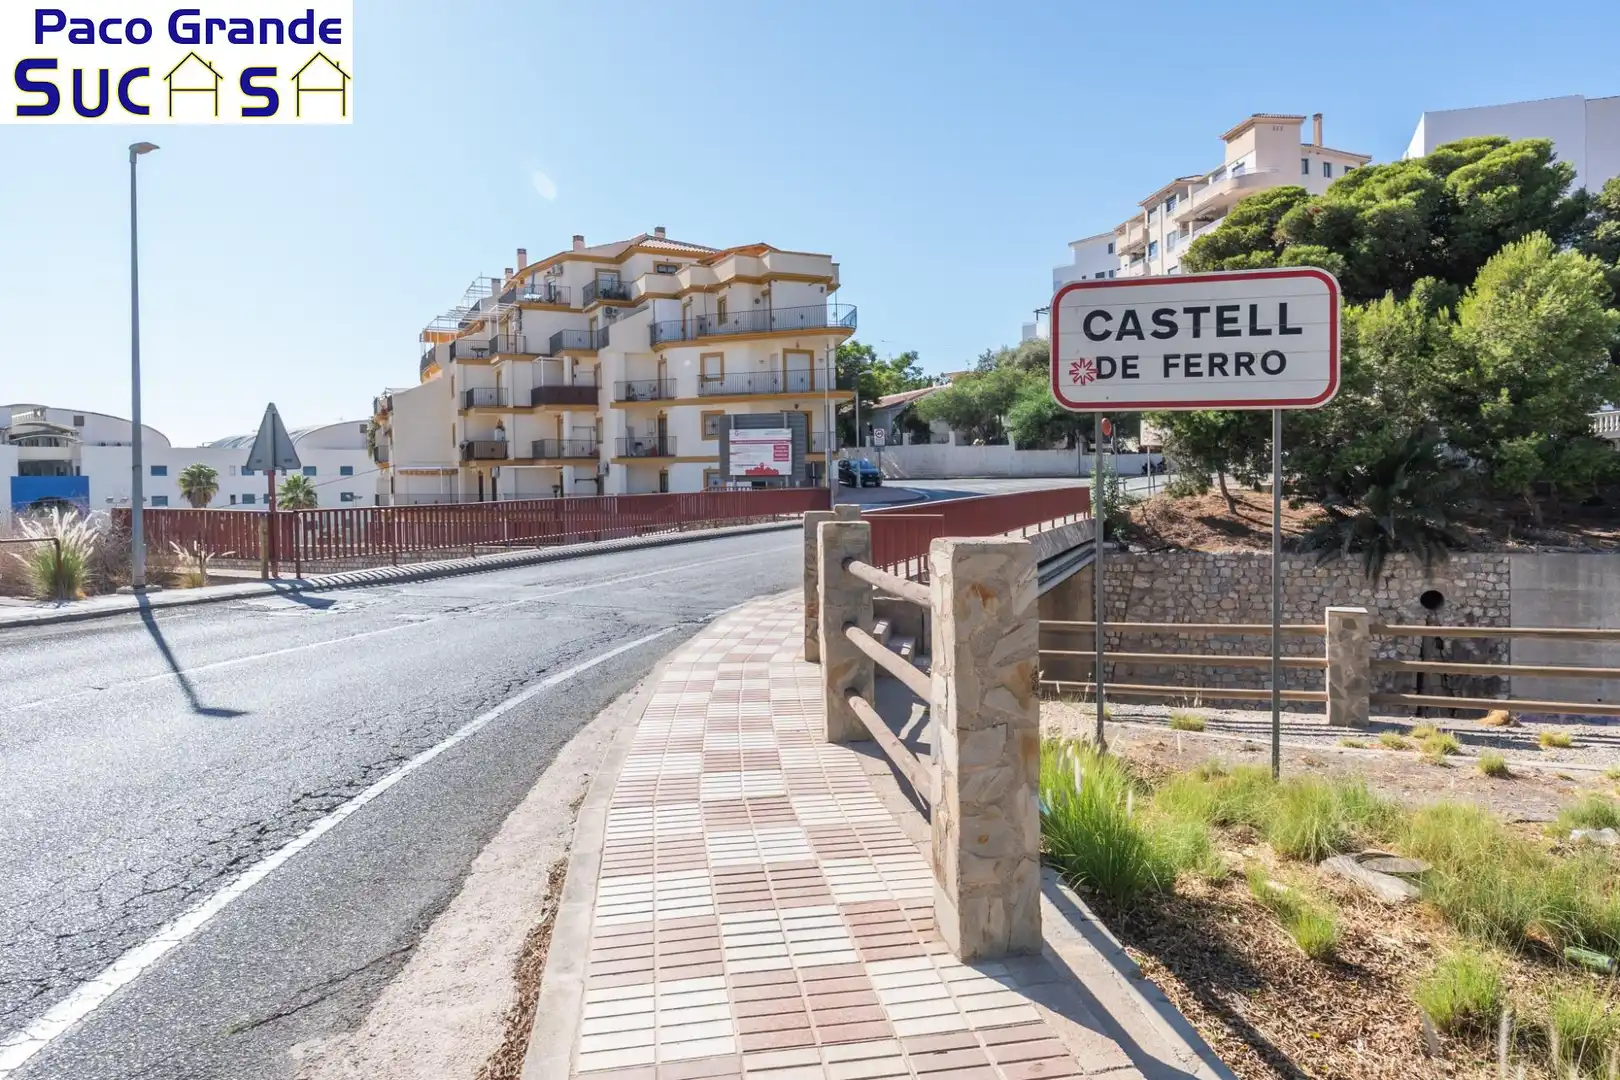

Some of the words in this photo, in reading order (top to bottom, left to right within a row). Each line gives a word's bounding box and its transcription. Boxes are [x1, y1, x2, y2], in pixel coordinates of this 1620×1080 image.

[1083, 302, 1302, 341] CASTELL
[1096, 355, 1140, 379] DE
[1163, 350, 1287, 378] FERRO
